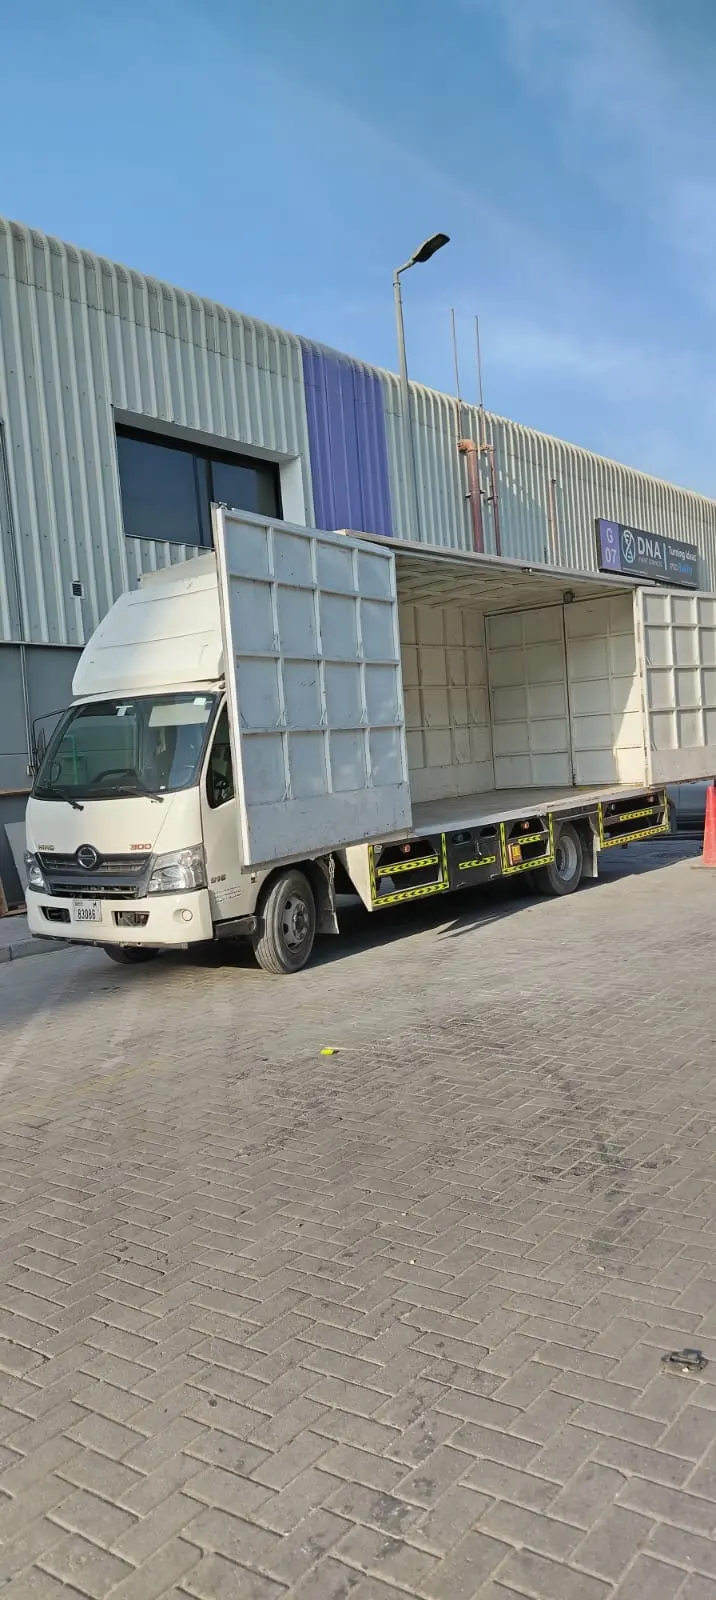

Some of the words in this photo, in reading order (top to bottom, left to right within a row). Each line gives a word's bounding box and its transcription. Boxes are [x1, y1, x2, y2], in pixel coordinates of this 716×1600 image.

[606, 527, 614, 544] G
[604, 547, 617, 563] 07
[637, 536, 662, 559] DNA
[668, 545, 686, 561] Turning
[130, 843, 152, 851] 300
